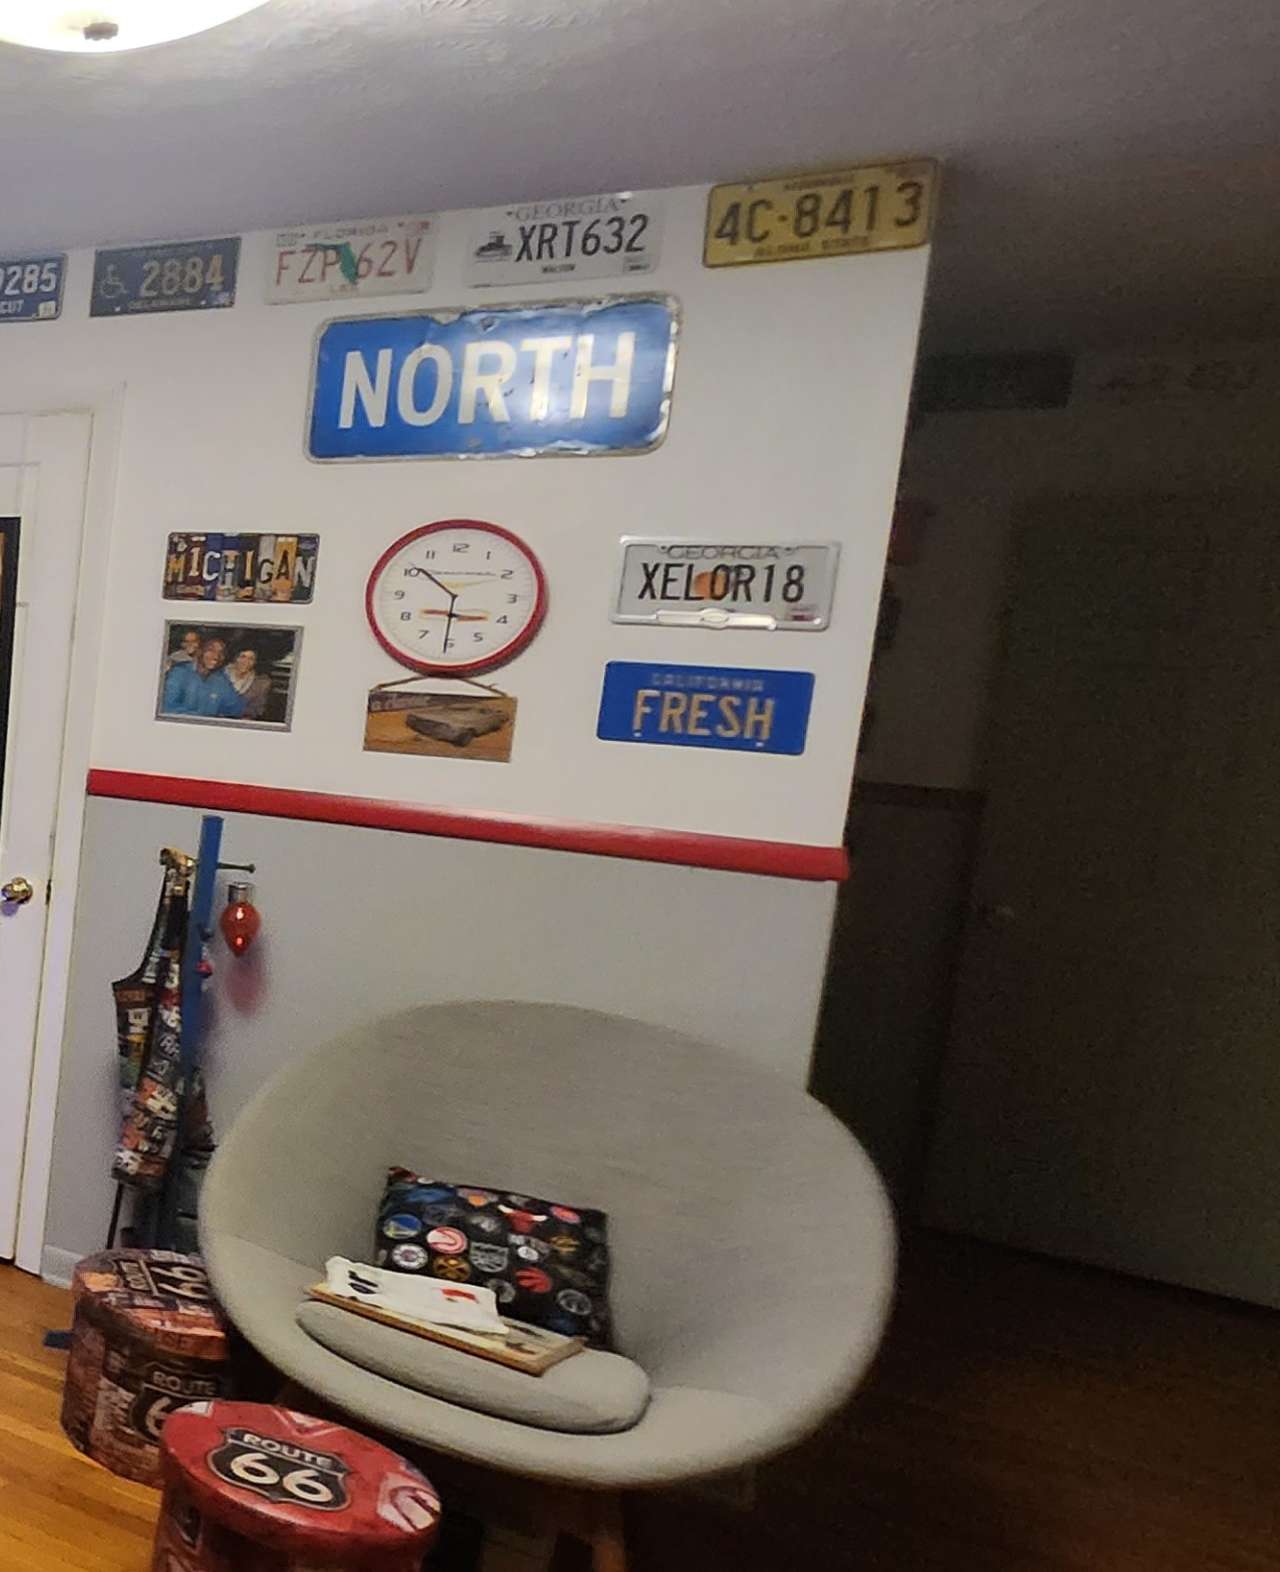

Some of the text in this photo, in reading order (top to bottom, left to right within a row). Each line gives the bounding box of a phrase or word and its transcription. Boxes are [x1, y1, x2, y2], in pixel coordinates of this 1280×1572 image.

[515, 198, 620, 221] GEORGIA
[514, 213, 650, 263] XRT632
[355, 237, 424, 279] 62V
[140, 254, 225, 298] 2884
[337, 330, 638, 431] NORTH
[425, 550, 436, 560] 11
[452, 543, 471, 553] 12
[666, 545, 780, 560] GEORGIA
[167, 546, 316, 588] MICHIGAN
[403, 567, 420, 577] 10
[500, 569, 515, 579] 2
[637, 562, 806, 603] XELOR18
[394, 590, 406, 600] 9
[506, 594, 518, 603] 3
[400, 611, 412, 621] 8
[496, 615, 508, 625] 4
[418, 630, 430, 639] 7
[473, 632, 483, 642] 5
[651, 672, 765, 692] CALIFORNIA
[632, 688, 776, 741] FRESH
[151, 1370, 216, 1395] ROUTE
[242, 1432, 333, 1467] ROUTE
[230, 1451, 334, 1503] 66
